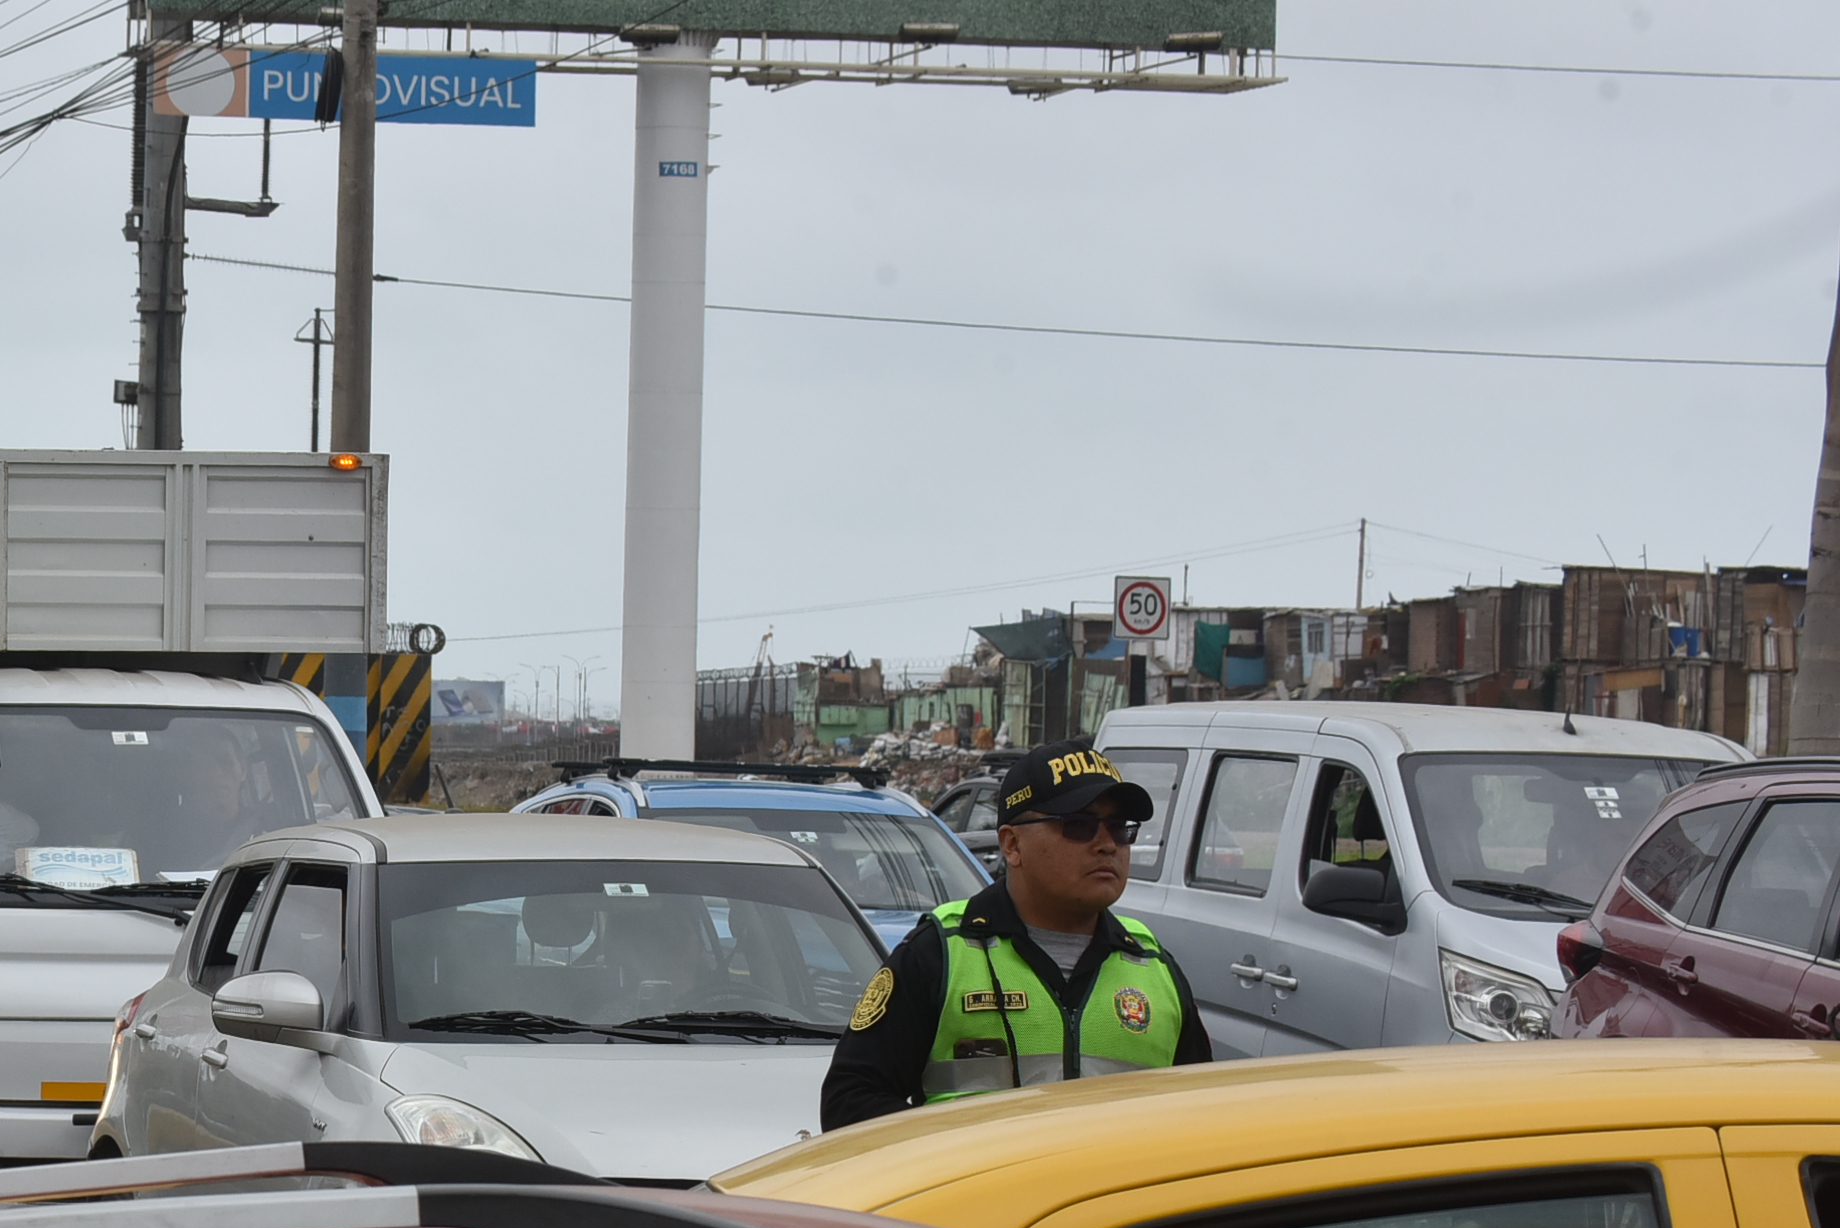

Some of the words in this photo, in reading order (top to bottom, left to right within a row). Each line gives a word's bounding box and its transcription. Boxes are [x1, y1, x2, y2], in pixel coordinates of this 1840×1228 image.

[263, 69, 522, 109] PUOVISUAL
[1130, 592, 1158, 617] 50
[1005, 784, 1033, 810] PERU
[38, 850, 123, 868] sedapal
